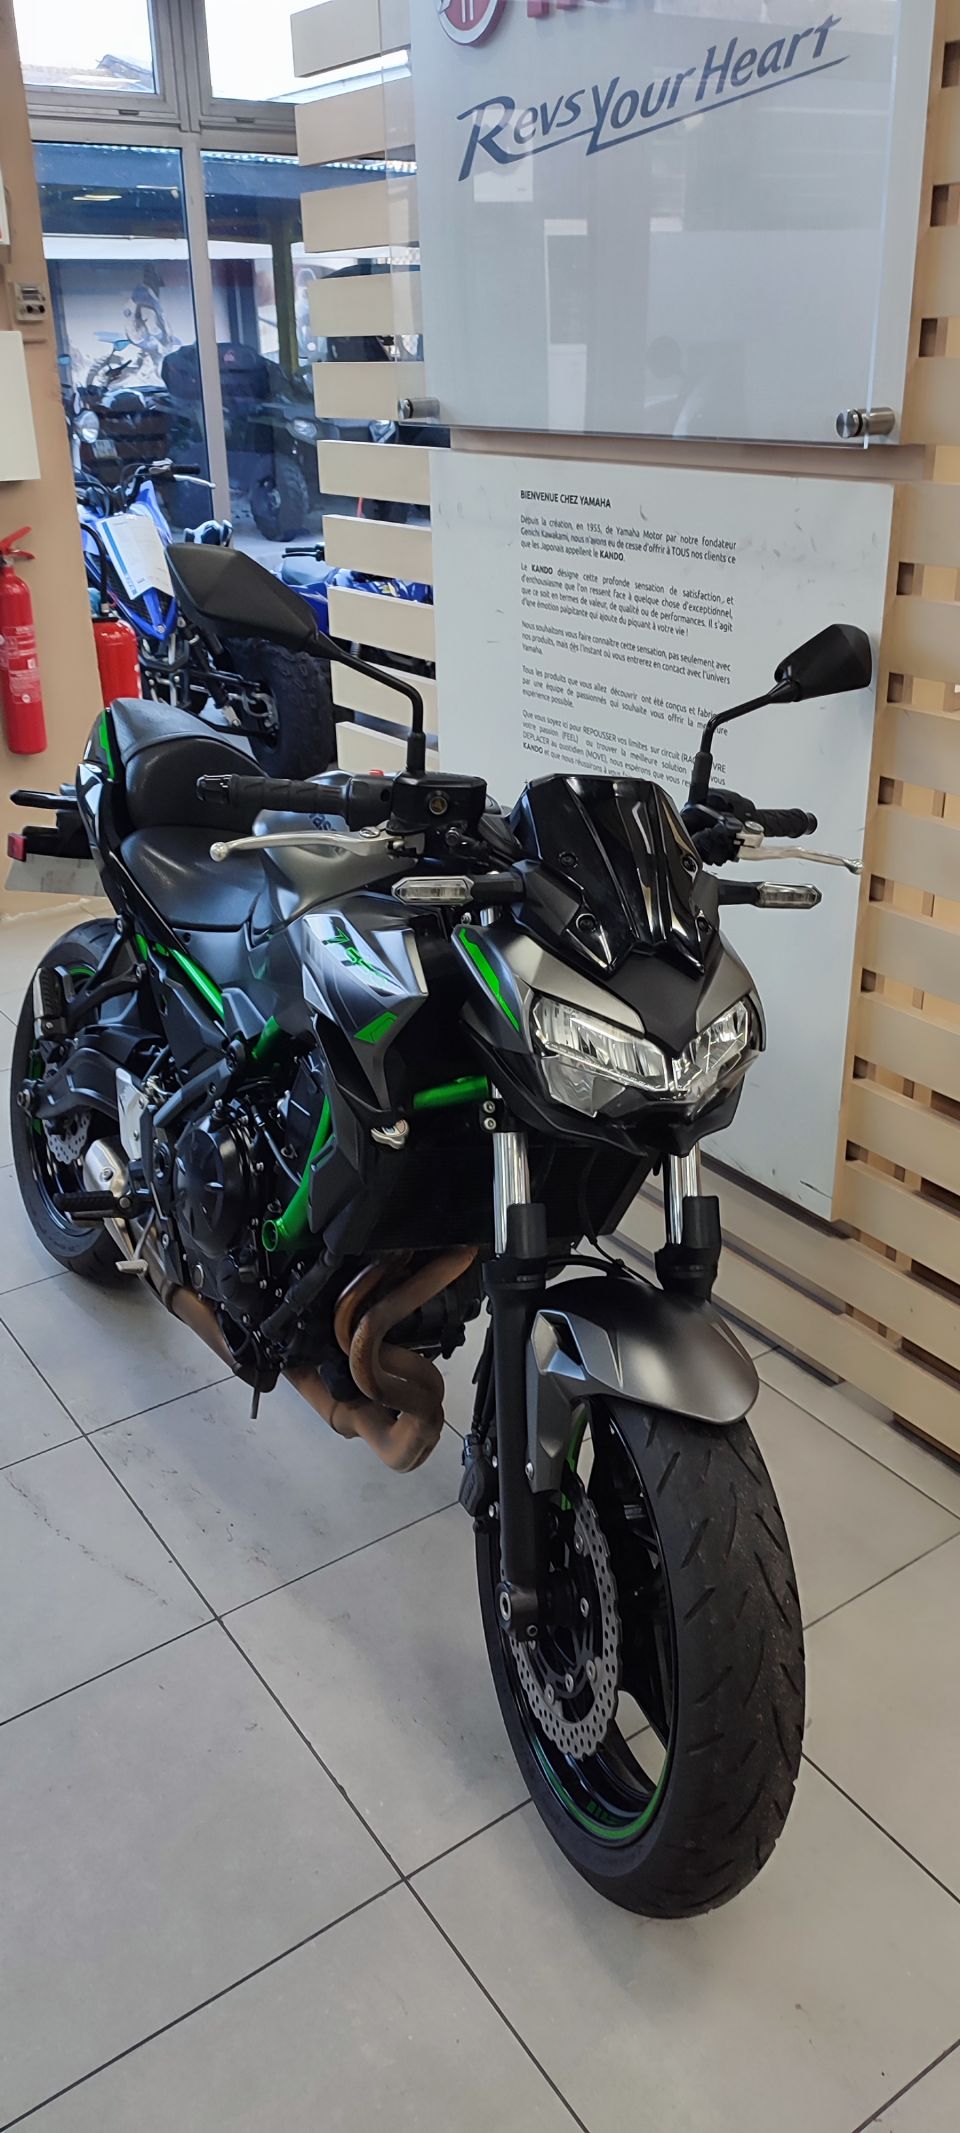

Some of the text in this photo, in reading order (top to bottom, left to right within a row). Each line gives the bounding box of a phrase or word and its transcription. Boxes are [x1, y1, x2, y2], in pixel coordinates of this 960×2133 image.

[456, 14, 842, 181] Revs Your Heart
[521, 491, 611, 508] BIENVENUE CHEZ YAMAHA
[606, 525, 613, 534] de
[616, 527, 639, 538] Yamaha
[643, 530, 663, 540] Motor
[666, 535, 677, 544] par
[680, 535, 698, 545] notre
[702, 537, 736, 550] fondateur
[617, 539, 624, 549] de
[625, 543, 642, 551] cesse
[643, 543, 665, 554] d'offrir
[672, 547, 690, 557] TOUS
[691, 551, 703, 559] nos
[704, 551, 726, 562] clients
[728, 556, 736, 564] ce
[532, 564, 553, 575] KANDO
[602, 577, 630, 588] profonde
[635, 582, 665, 593] sensation
[670, 586, 678, 595] de
[727, 596, 734, 605] et
[614, 590, 626, 600] face
[634, 595, 659, 607] quelque
[662, 598, 680, 609] chose
[610, 601, 617, 610] de
[619, 605, 639, 615] qualité
[651, 609, 658, 618] de
[715, 621, 733, 634] s'agit
[619, 616, 626, 625] du
[628, 618, 651, 630] piquant
[657, 624, 674, 634] votre
[675, 627, 685, 636] vie
[604, 650, 611, 658] où
[612, 653, 625, 661] vous
[627, 655, 652, 667] entrerez
[662, 664, 685, 675] contact
[687, 669, 701, 678] avec
[703, 670, 731, 685] l'univers
[621, 642, 635, 651] cette
[669, 652, 679, 662] pas
[681, 655, 714, 668] seulement
[716, 662, 731, 672] avec
[610, 686, 637, 701] découvrir
[641, 696, 652, 704] ont
[654, 697, 664, 707] été
[666, 702, 687, 714] conçus
[689, 707, 695, 715] et
[610, 700, 619, 708] qui
[622, 703, 647, 715] souhaite
[650, 710, 664, 719] vous
[668, 713, 684, 724] offrir
[523, 741, 543, 754] KANDO
